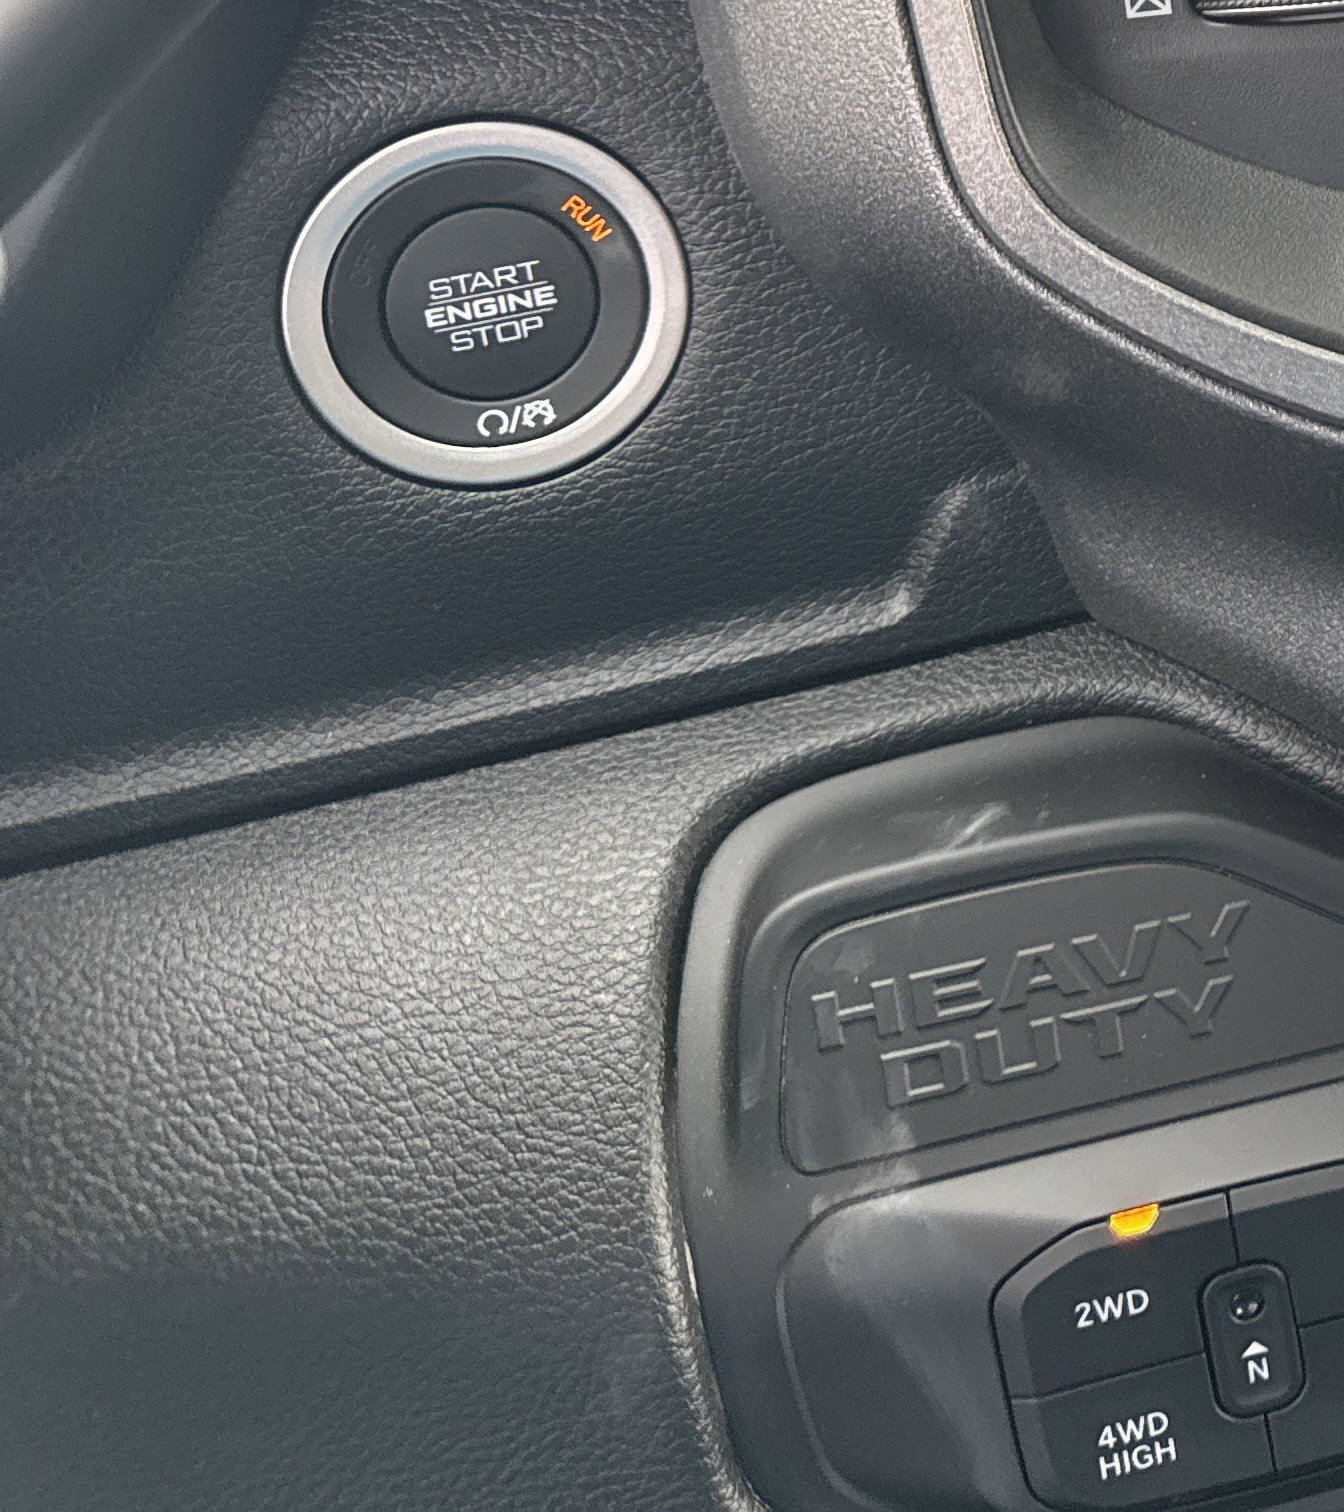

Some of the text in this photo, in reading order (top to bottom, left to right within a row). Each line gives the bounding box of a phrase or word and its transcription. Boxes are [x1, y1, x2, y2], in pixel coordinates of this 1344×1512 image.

[561, 195, 613, 242] RUN
[429, 261, 540, 301] START
[425, 286, 558, 329] ENGINE
[450, 316, 543, 352] STOP
[811, 899, 1251, 1052] HEAVY
[880, 974, 1233, 1109] DUTY
[1075, 1288, 1150, 1329] 2WD
[1247, 1356, 1269, 1384] N
[1098, 1411, 1170, 1451] 4WD
[1099, 1437, 1177, 1481] HIGH
